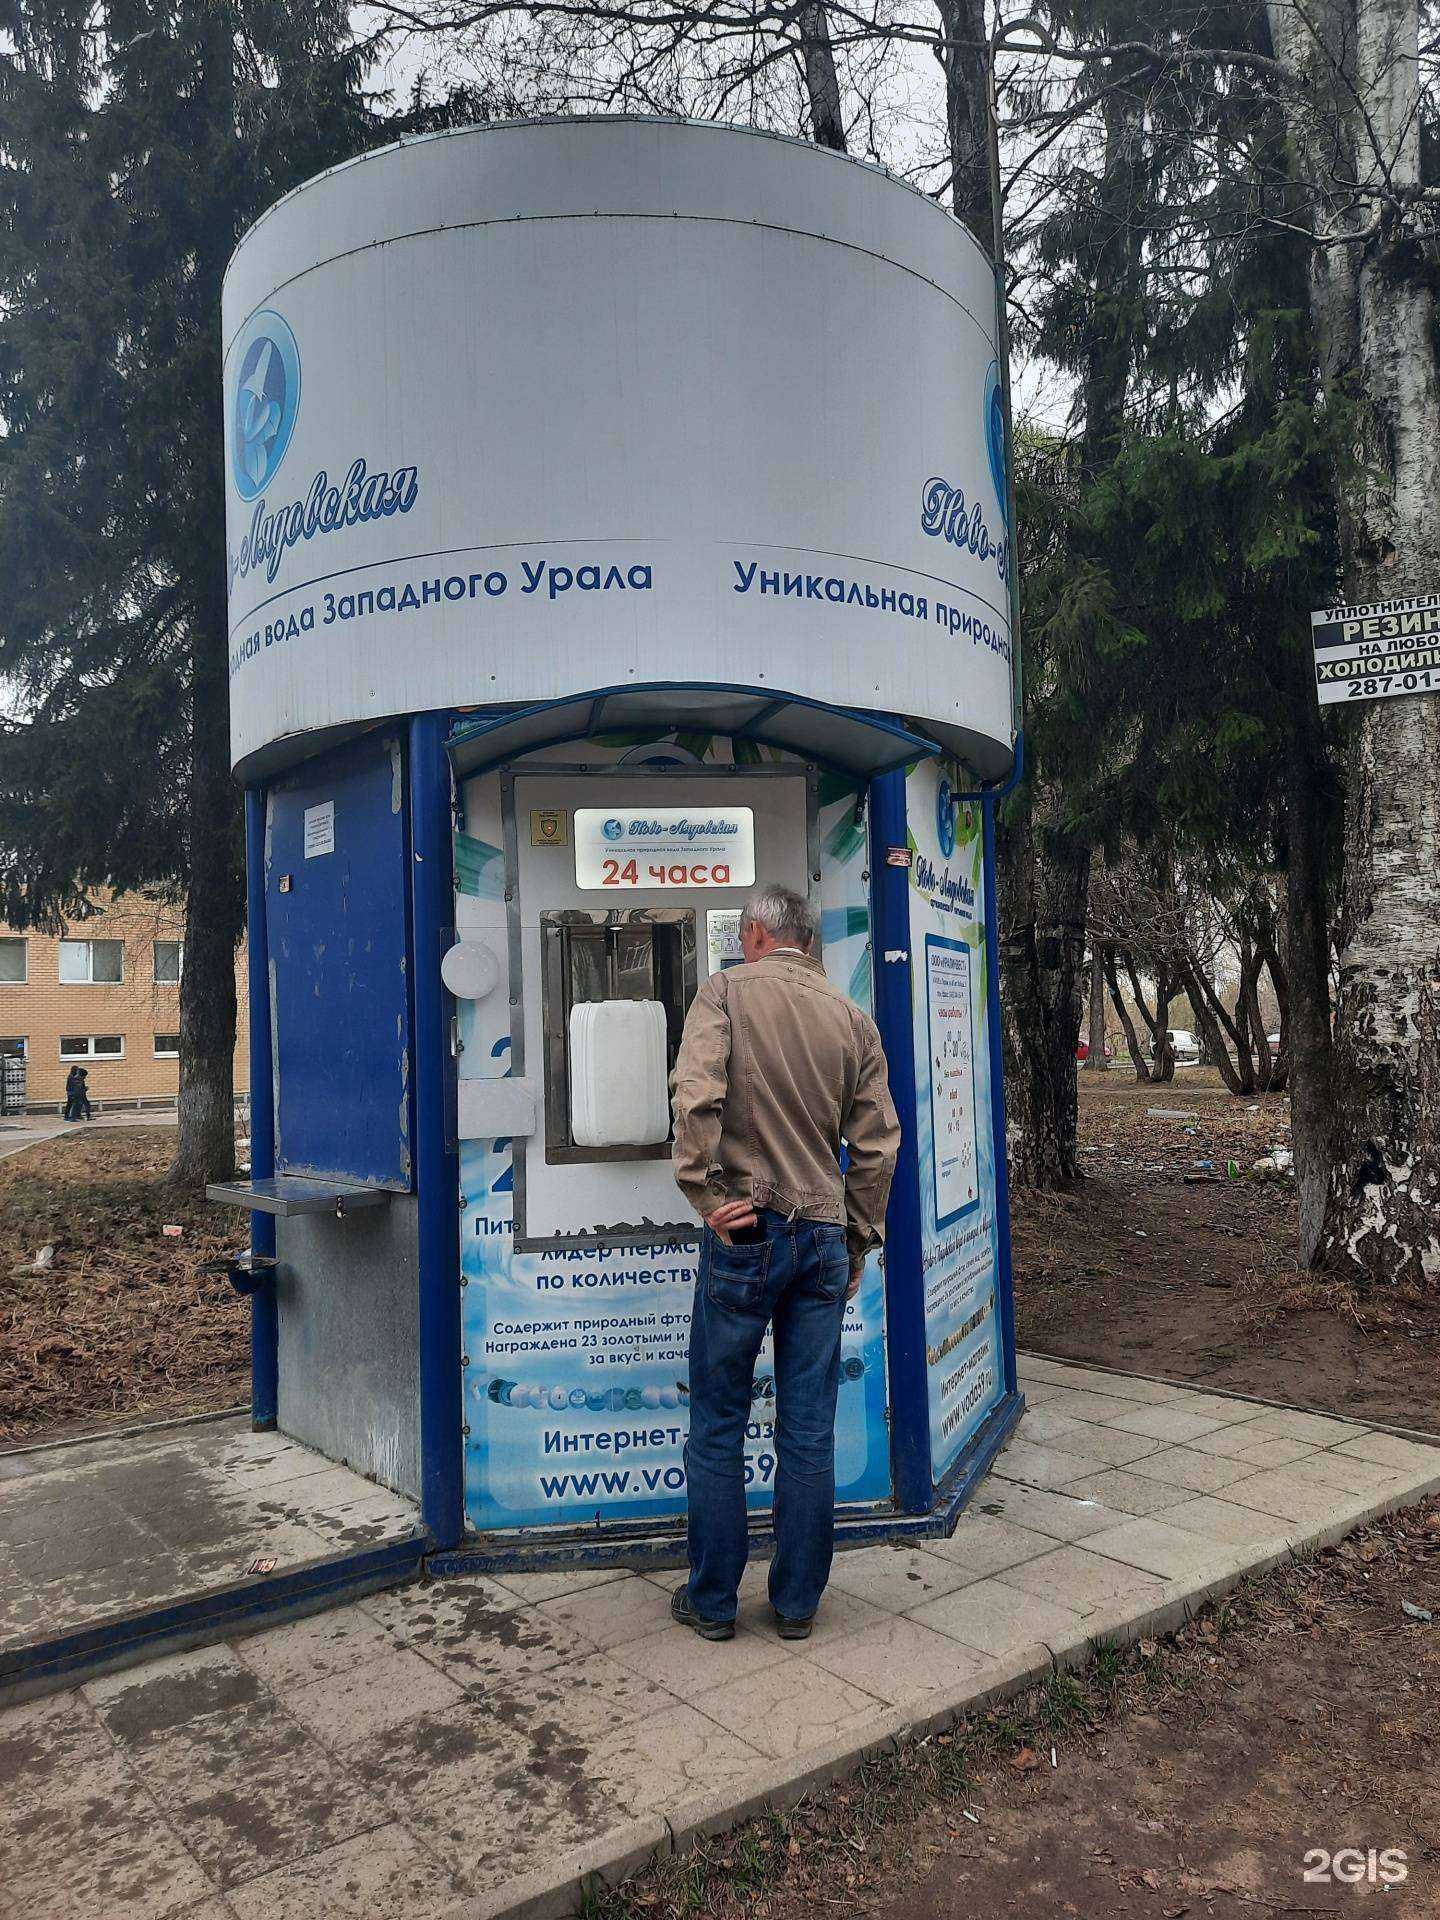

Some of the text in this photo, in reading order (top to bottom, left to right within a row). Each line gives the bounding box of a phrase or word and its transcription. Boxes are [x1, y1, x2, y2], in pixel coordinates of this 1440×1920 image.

[229, 458, 419, 593] -Лядовская
[732, 559, 929, 620] Уникальная
[230, 560, 653, 678] одная вода Западного Урала
[1325, 594, 1440, 622] УПЛОТНИТЕЛ
[1343, 609, 1440, 642] РЕЗИН
[1358, 634, 1440, 656] НА ЛЮБО
[1347, 671, 1440, 698] 287-01-
[628, 818, 738, 841] Ново-Лядовская
[601, 858, 730, 885] 24 часа
[536, 1274, 565, 1290] по
[493, 1312, 691, 1336] Содержит природный фто
[485, 1331, 685, 1354] Награждена 23 золотыми и
[589, 1348, 690, 1366] за вкус и каче
